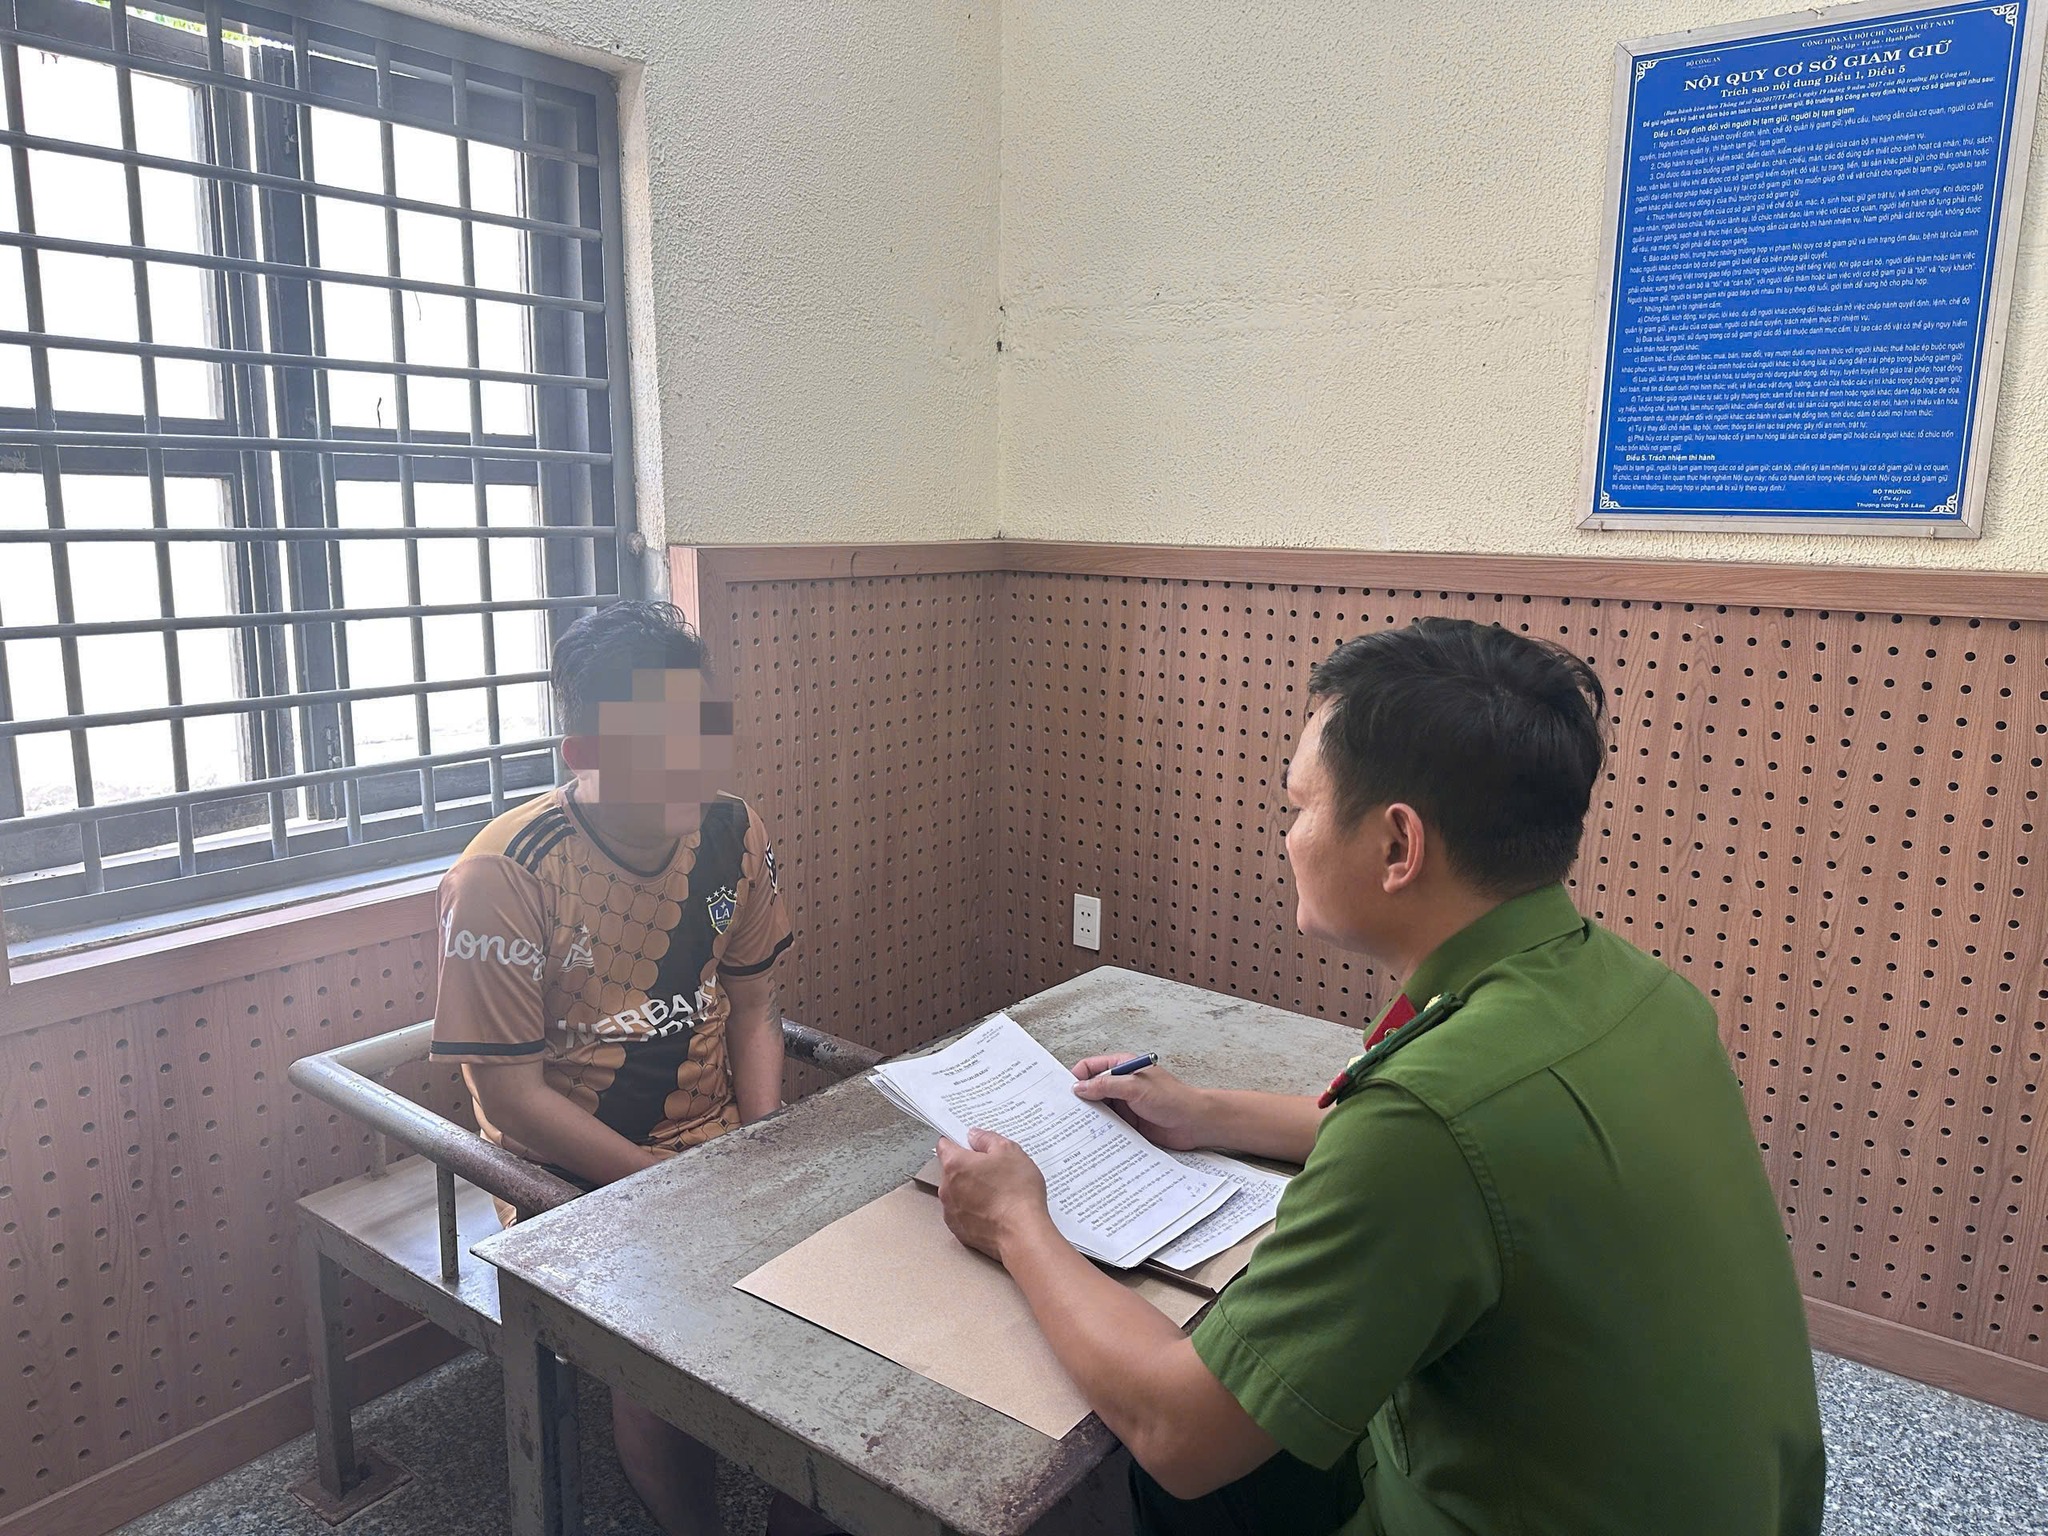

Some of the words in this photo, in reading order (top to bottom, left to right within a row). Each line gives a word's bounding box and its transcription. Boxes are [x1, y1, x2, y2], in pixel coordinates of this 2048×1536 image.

[1684, 75, 1720, 91] NỘI
[1726, 69, 1768, 85] QUY
[1774, 62, 1803, 77] CƠ
[1809, 55, 1837, 72] SỞ
[1844, 49, 1901, 67] GIAM
[1909, 40, 1952, 58] GIỮ
[1721, 87, 1748, 97] Trích
[1773, 81, 1790, 91] nội
[1794, 78, 1821, 87] dung
[1825, 72, 1850, 83] Điều
[1856, 71, 1864, 80] 1,
[1868, 66, 1894, 77] Điều
[1899, 65, 1905, 73] 5
[1654, 130, 1668, 138] Điều
[1708, 123, 1718, 131] đối
[1732, 119, 1751, 129] người
[1753, 118, 1759, 126] bị
[1776, 115, 1789, 124] giữ,
[1791, 112, 1811, 121] người
[1813, 110, 1819, 118] bị
[1837, 108, 1854, 116] giam
[715, 908, 730, 920] LA
